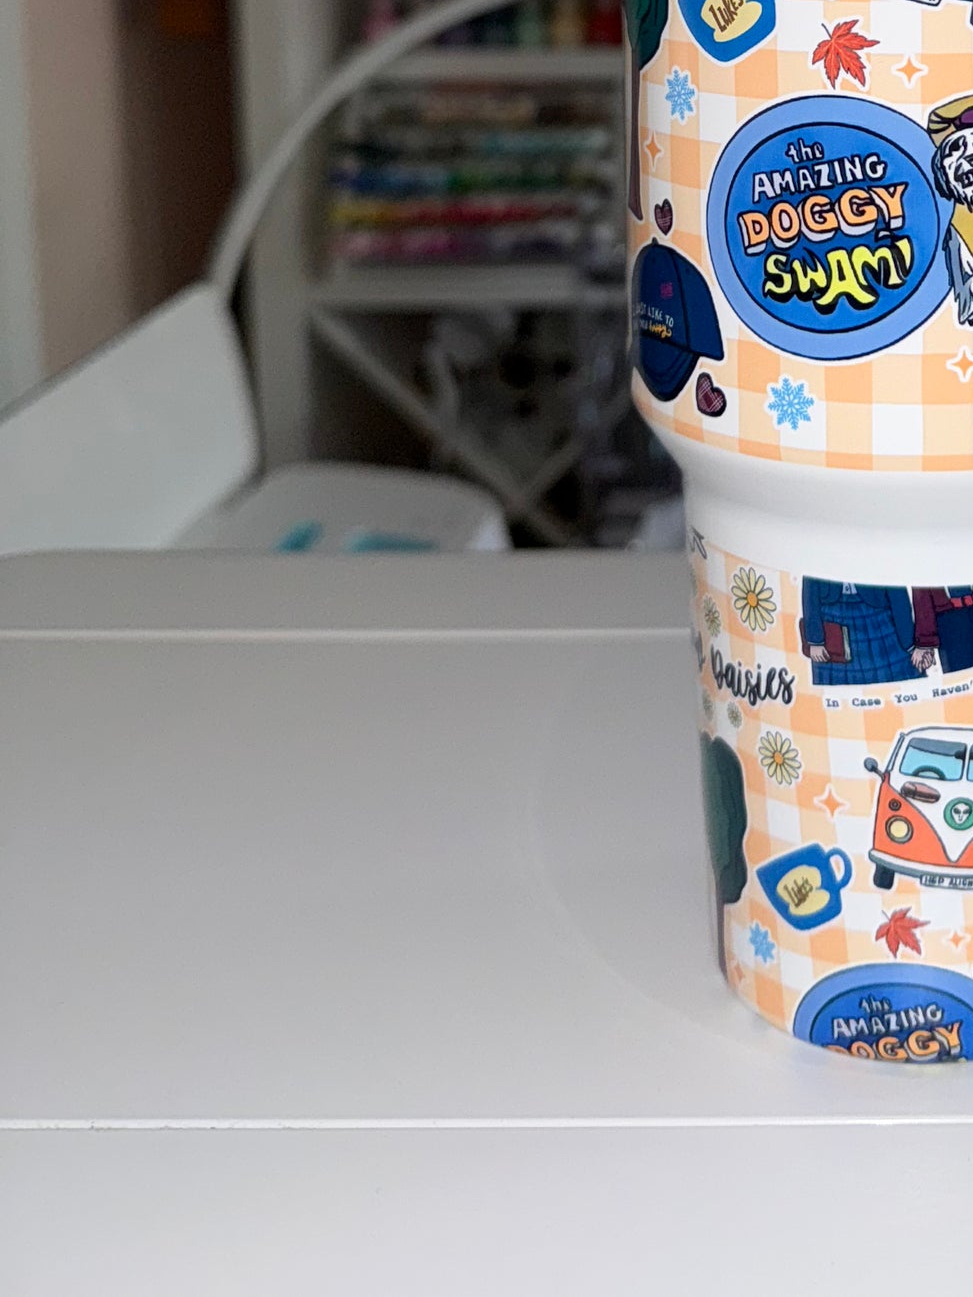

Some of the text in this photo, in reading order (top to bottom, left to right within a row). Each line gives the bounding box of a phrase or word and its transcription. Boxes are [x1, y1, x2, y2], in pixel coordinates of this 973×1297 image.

[786, 138, 824, 164] the
[752, 153, 888, 203] AMAZING
[738, 182, 909, 256] DOGGY
[763, 229, 914, 315] SWAMI
[710, 644, 796, 707] Daisies
[825, 698, 840, 708] In
[852, 697, 882, 707] Case
[894, 693, 918, 704] You
[832, 1003, 945, 1040] AMAZING
